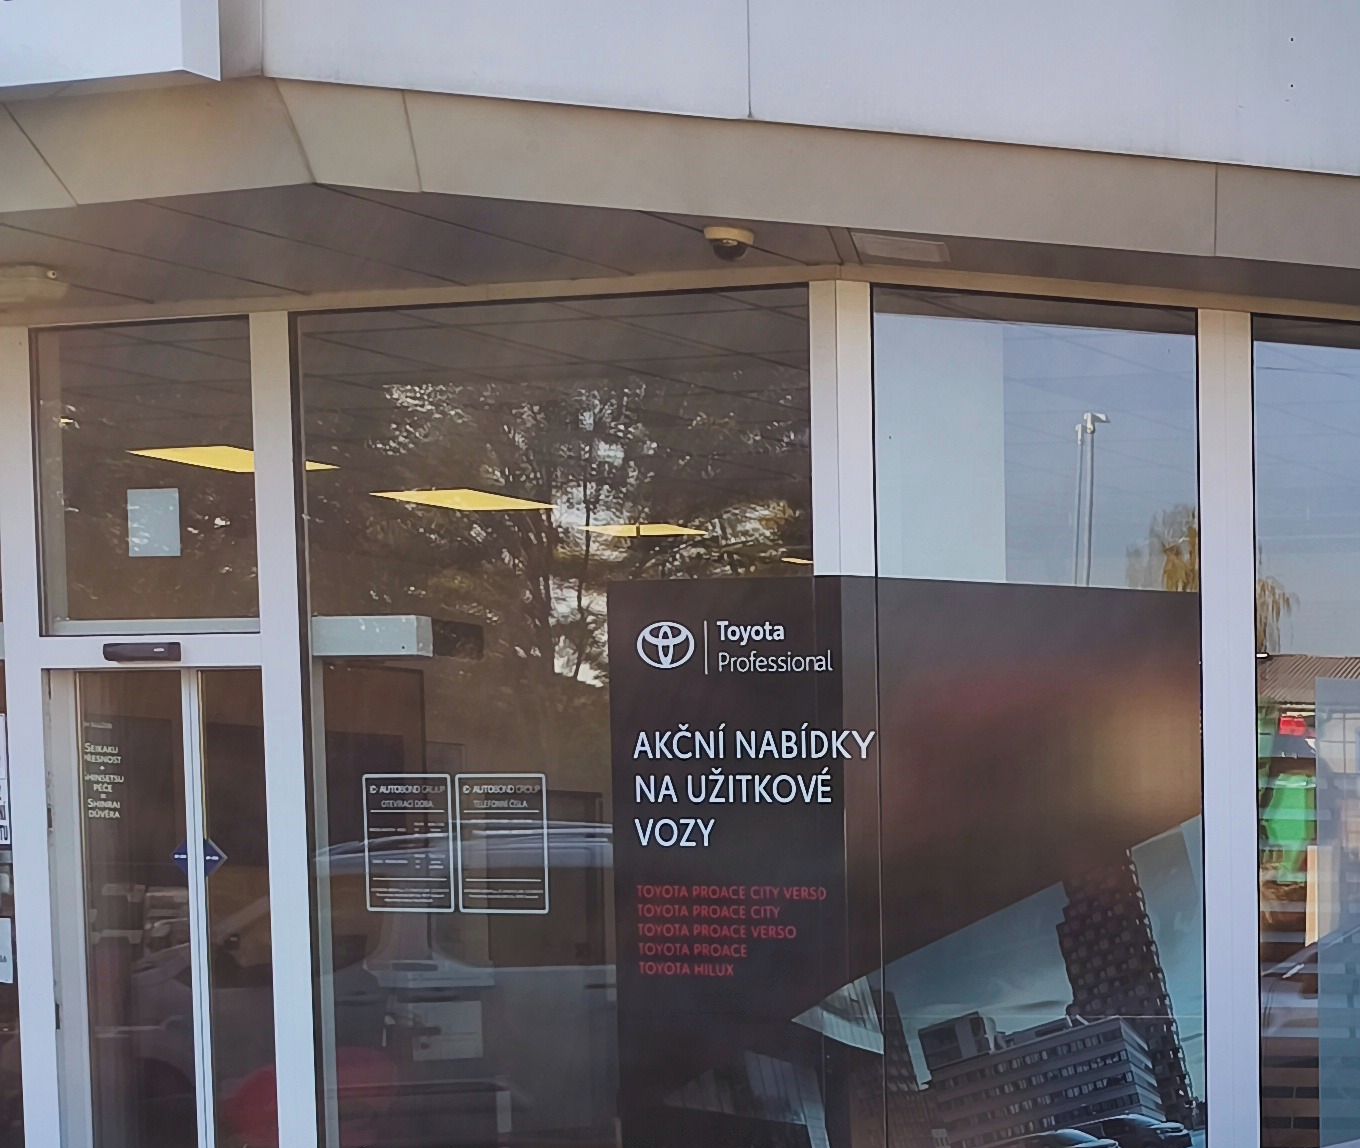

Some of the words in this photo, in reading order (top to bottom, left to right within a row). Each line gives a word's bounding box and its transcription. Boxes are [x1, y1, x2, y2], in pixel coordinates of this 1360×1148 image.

[716, 620, 784, 646] Toyota
[718, 650, 833, 672] Professional
[633, 723, 726, 759] AKČNÍ
[736, 722, 876, 759] NABÍDKY
[635, 775, 678, 803] NA
[687, 766, 832, 803] UŽITKOVÉ
[634, 818, 715, 847] VOZY
[637, 885, 688, 898] TOYOTA
[692, 886, 746, 899] PROACE
[750, 886, 780, 900] CITY
[638, 904, 689, 918] TOYOTA
[692, 905, 746, 918] PROACE
[750, 906, 780, 919] CITY
[638, 924, 690, 938] TOYOTA
[693, 924, 747, 938] PROACE
[752, 926, 797, 939] VERSO
[638, 942, 690, 956] TOYOTA
[694, 944, 748, 958] PROACE
[639, 962, 690, 976] TOYOTA
[694, 962, 734, 976] HILUX
